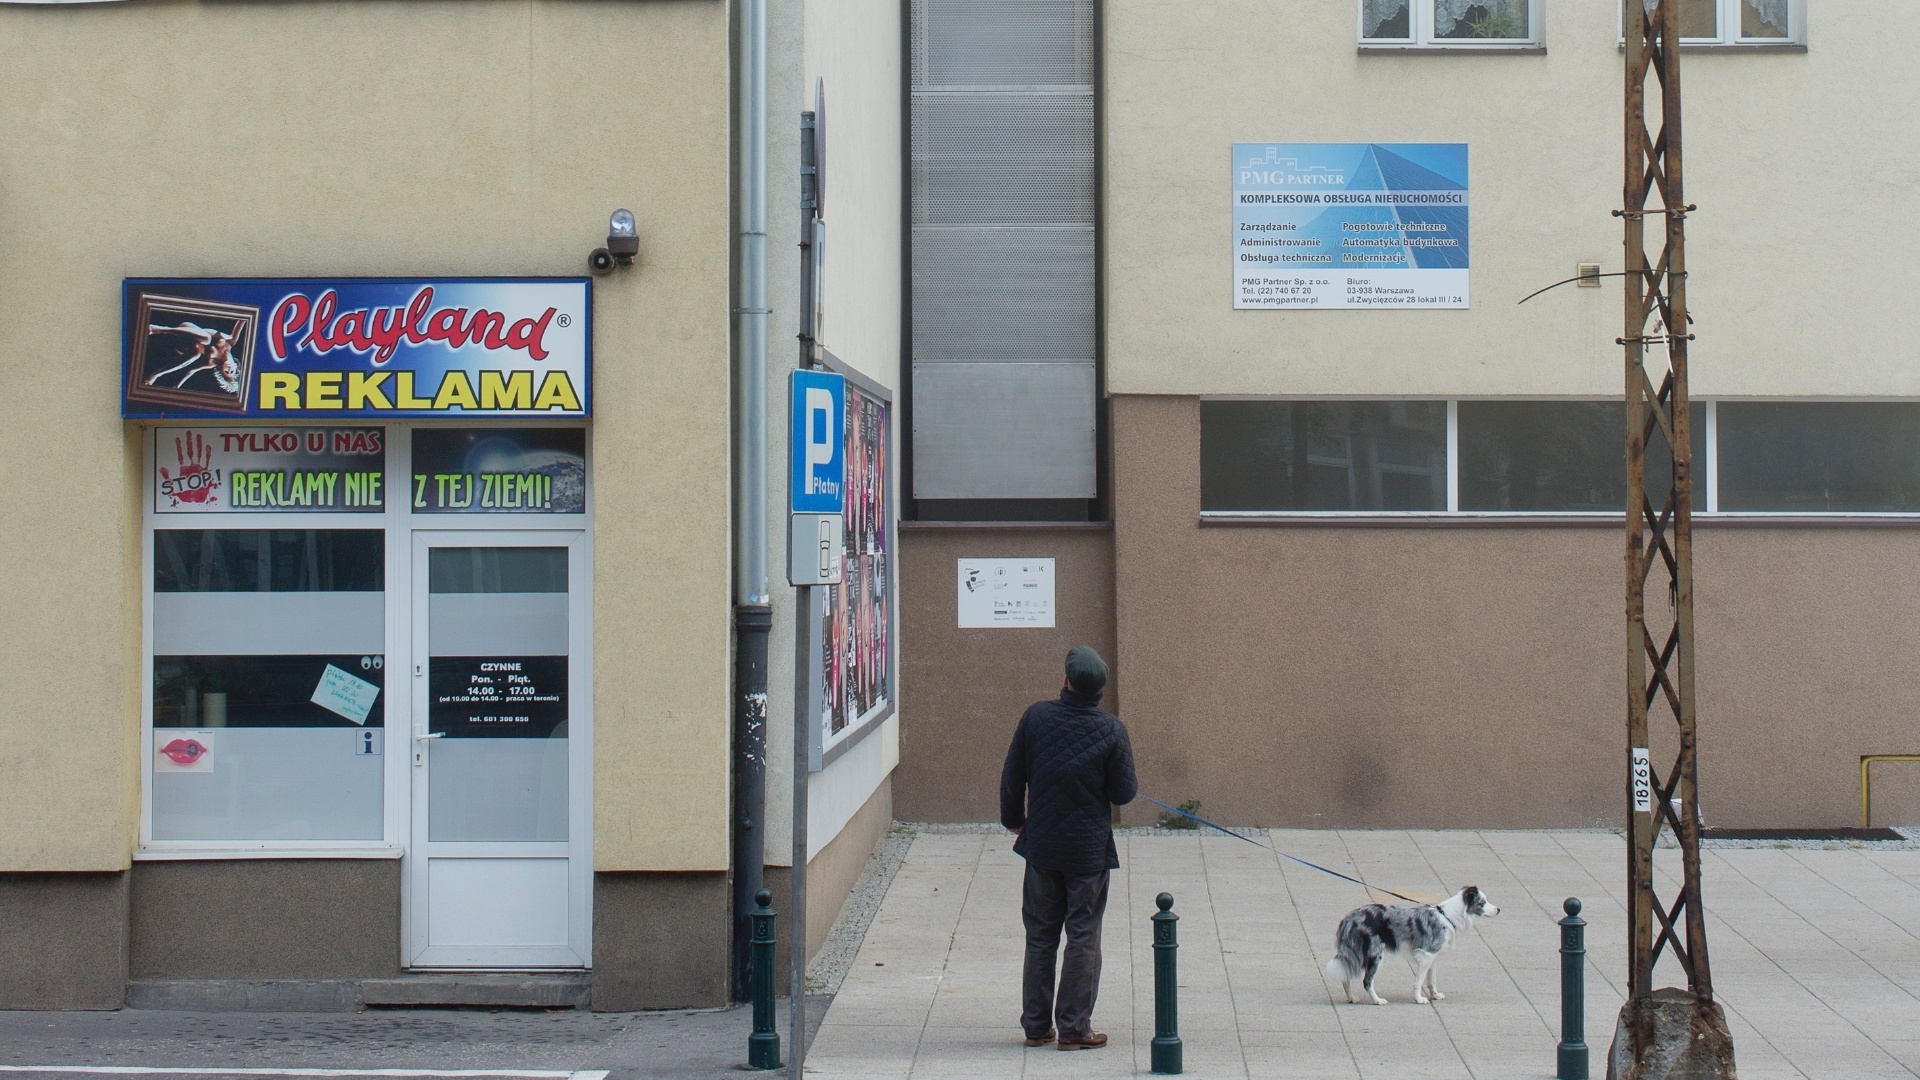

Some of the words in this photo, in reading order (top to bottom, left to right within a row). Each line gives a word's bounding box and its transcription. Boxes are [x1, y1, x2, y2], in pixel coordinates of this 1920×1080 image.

[1240, 171, 1284, 185] PMG
[1288, 174, 1344, 185] PARTNER
[1240, 194, 1321, 204] KOMPLEKSOWA
[1323, 194, 1372, 204] OBSŁUGA
[1375, 192, 1462, 204] NIERUCHOMOŚCI
[1240, 222, 1297, 232] Zarządzanie
[1342, 222, 1393, 233] Pogotowie
[1396, 222, 1446, 232] techniczne
[1240, 238, 1321, 247] Administrowanie
[1342, 238, 1400, 248] Automatyka
[1403, 238, 1458, 248] budynkowa
[1240, 253, 1279, 264] Obsługa
[1282, 253, 1332, 262] techniczna
[1342, 253, 1406, 264] Modernizacje
[1294, 278, 1306, 286] Sp.
[1258, 287, 1272, 295] (22)
[1242, 296, 1318, 305] www.pmgpartner.pl
[1347, 296, 1404, 305] ul.Zwycięzców
[258, 370, 583, 411] REKLAMA
[220, 432, 298, 452] TYLKO
[308, 433, 324, 452] U
[334, 432, 380, 453] NAS
[805, 388, 834, 494] P
[232, 472, 338, 506] REKLAMY
[345, 472, 382, 506] NIE
[414, 474, 428, 508] Z
[434, 474, 474, 508] TEJ
[481, 474, 552, 509] ZIEMI!
[813, 476, 840, 500] Płatny
[480, 662, 522, 671] CZYNNE
[471, 675, 493, 683] Pon.
[508, 675, 531, 685] Piąt.
[467, 687, 494, 695] 14.00
[509, 687, 535, 695] 17.00
[1634, 756, 1649, 806] 18265
